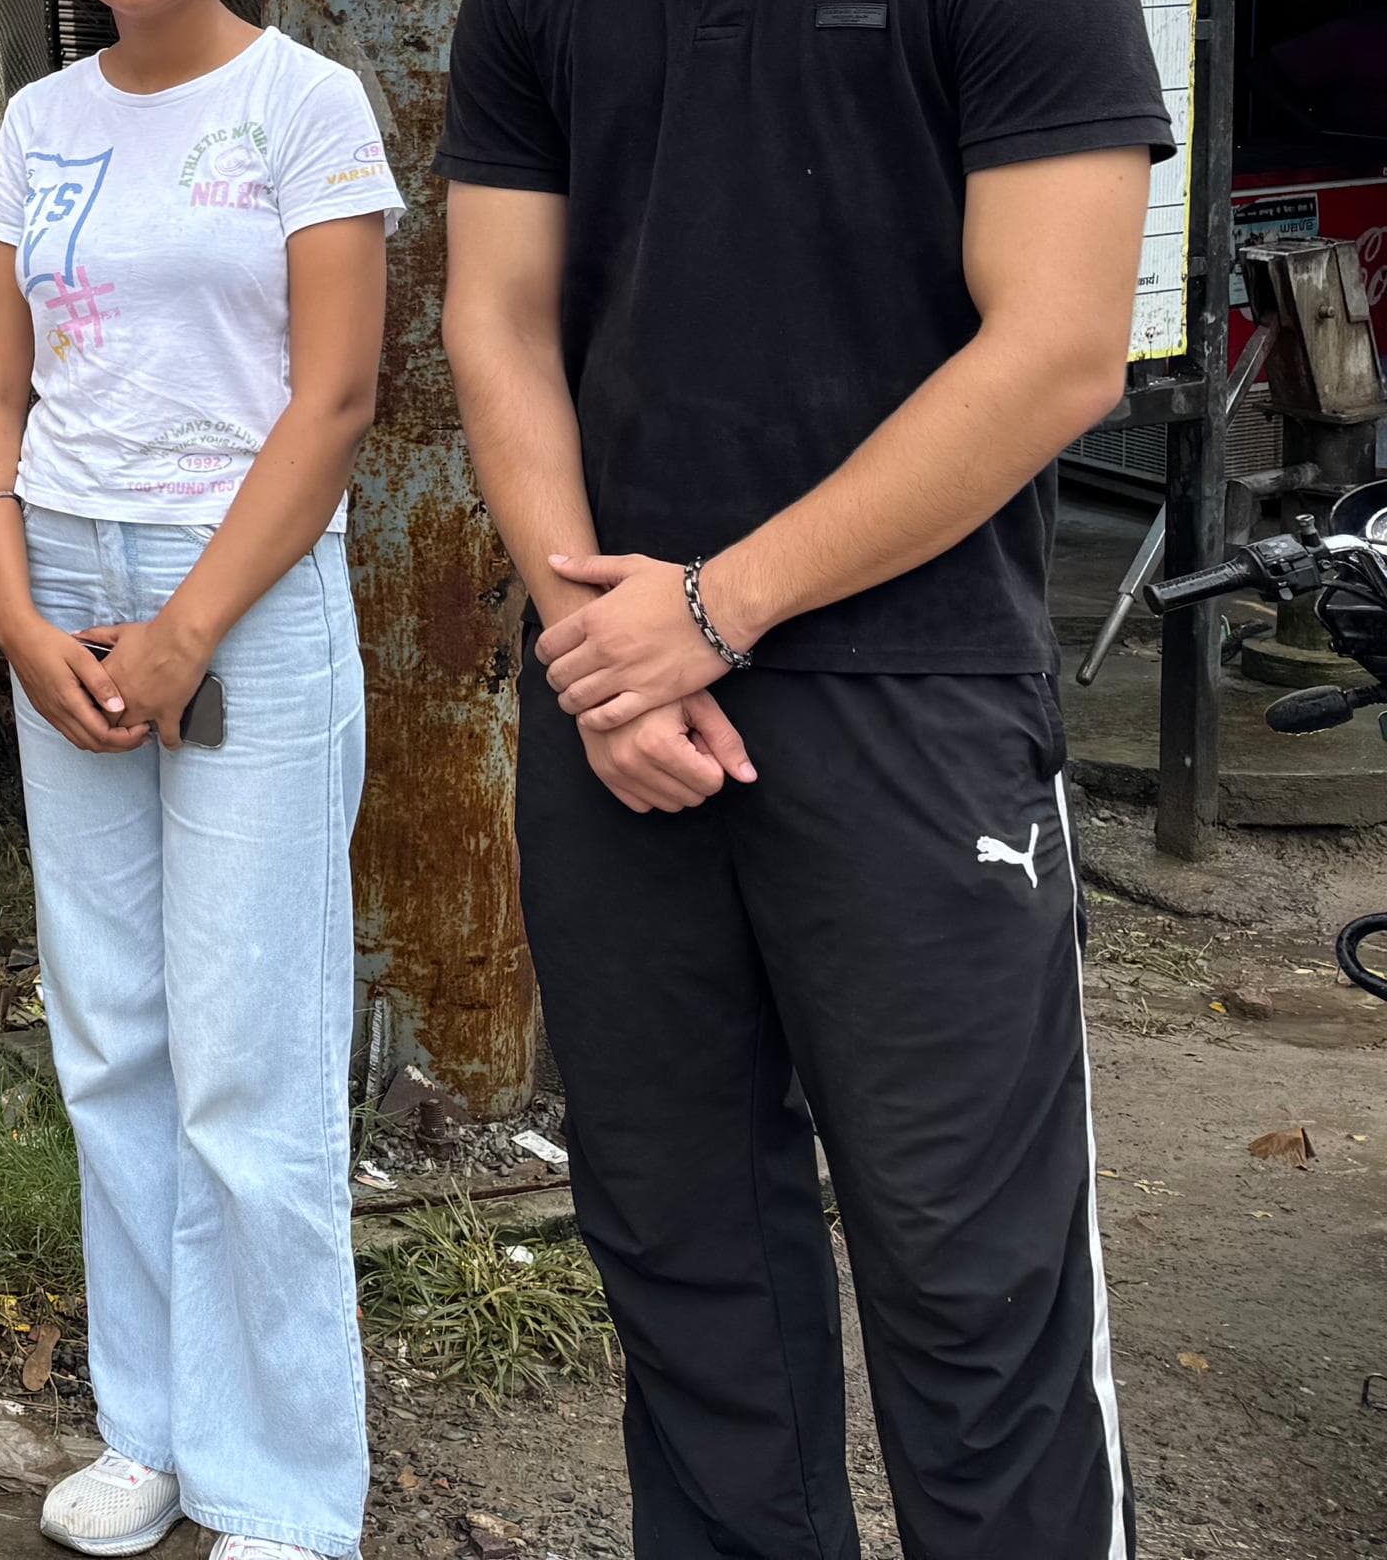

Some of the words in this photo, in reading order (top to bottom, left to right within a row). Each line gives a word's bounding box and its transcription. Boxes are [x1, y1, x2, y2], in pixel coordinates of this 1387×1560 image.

[178, 129, 228, 189] ATHLETIC
[326, 164, 386, 185] VARSIT
[170, 419, 211, 438] WAYS
[215, 420, 235, 434] OF
[186, 456, 221, 469] 1992
[156, 481, 205, 495] YOUNG
[209, 480, 235, 494] TOO
